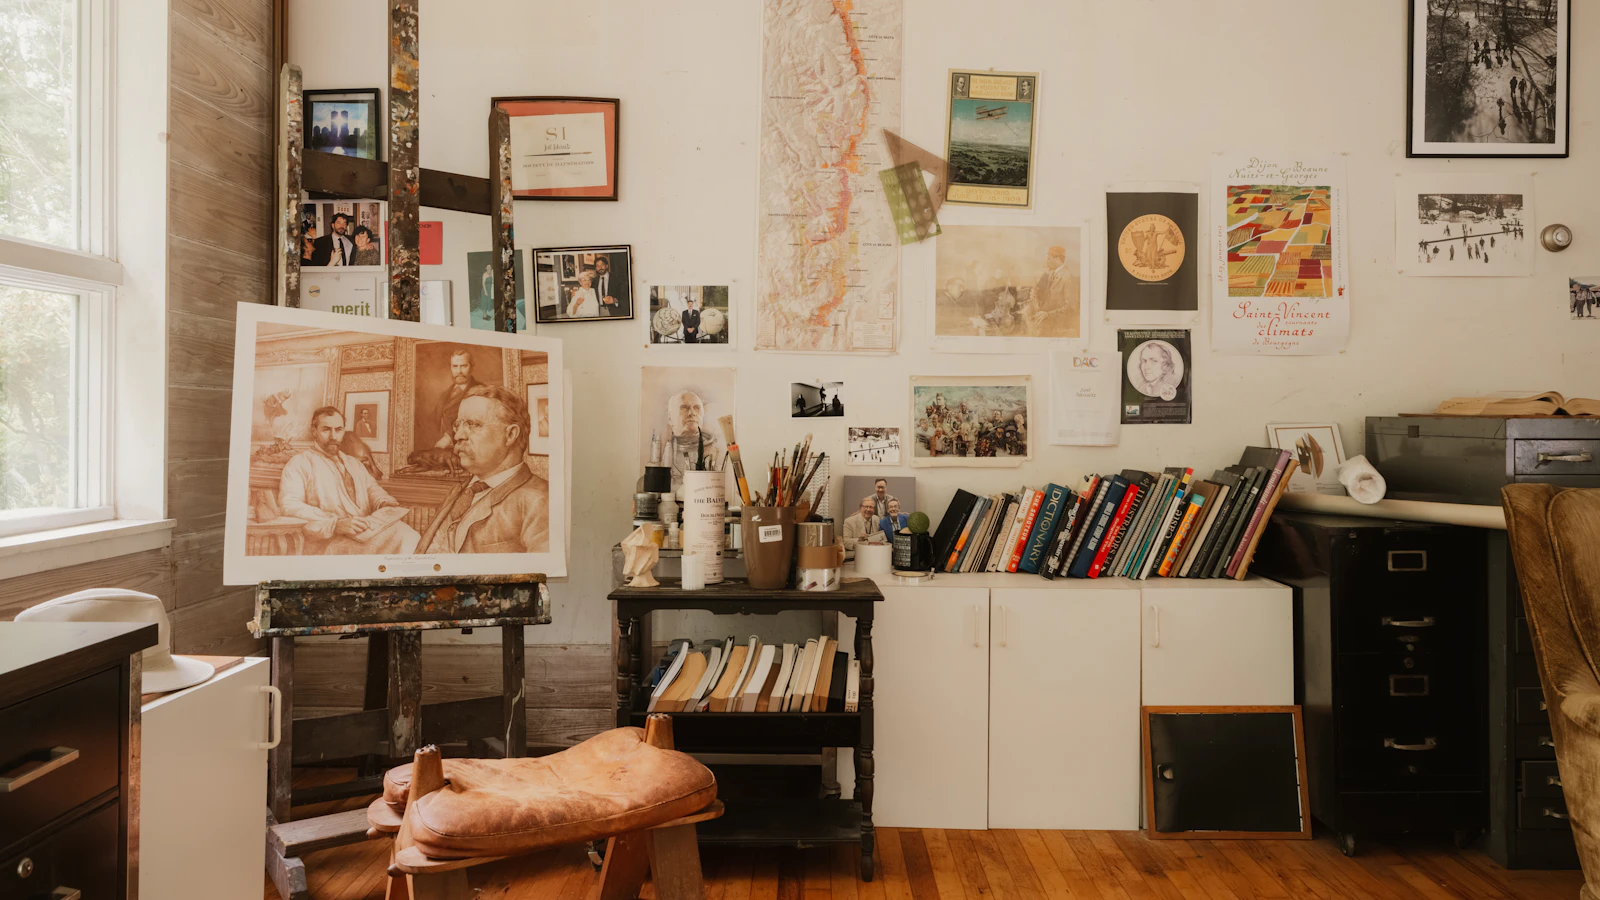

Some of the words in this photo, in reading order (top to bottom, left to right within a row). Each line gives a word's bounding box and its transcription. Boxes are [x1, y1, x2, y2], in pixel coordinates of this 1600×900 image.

[1247, 157, 1278, 172] Dijon
[1293, 161, 1328, 173] Beaune
[332, 301, 370, 316] merit
[1233, 301, 1331, 319] Saint-Vincent
[1259, 317, 1314, 336] climats
[1073, 357, 1099, 367] DAC
[1260, 468, 1281, 505] Rembrandt
[1033, 494, 1041, 507] THE
[1021, 508, 1036, 540] SABOTEUR
[1028, 488, 1062, 565] DICTIONARY
